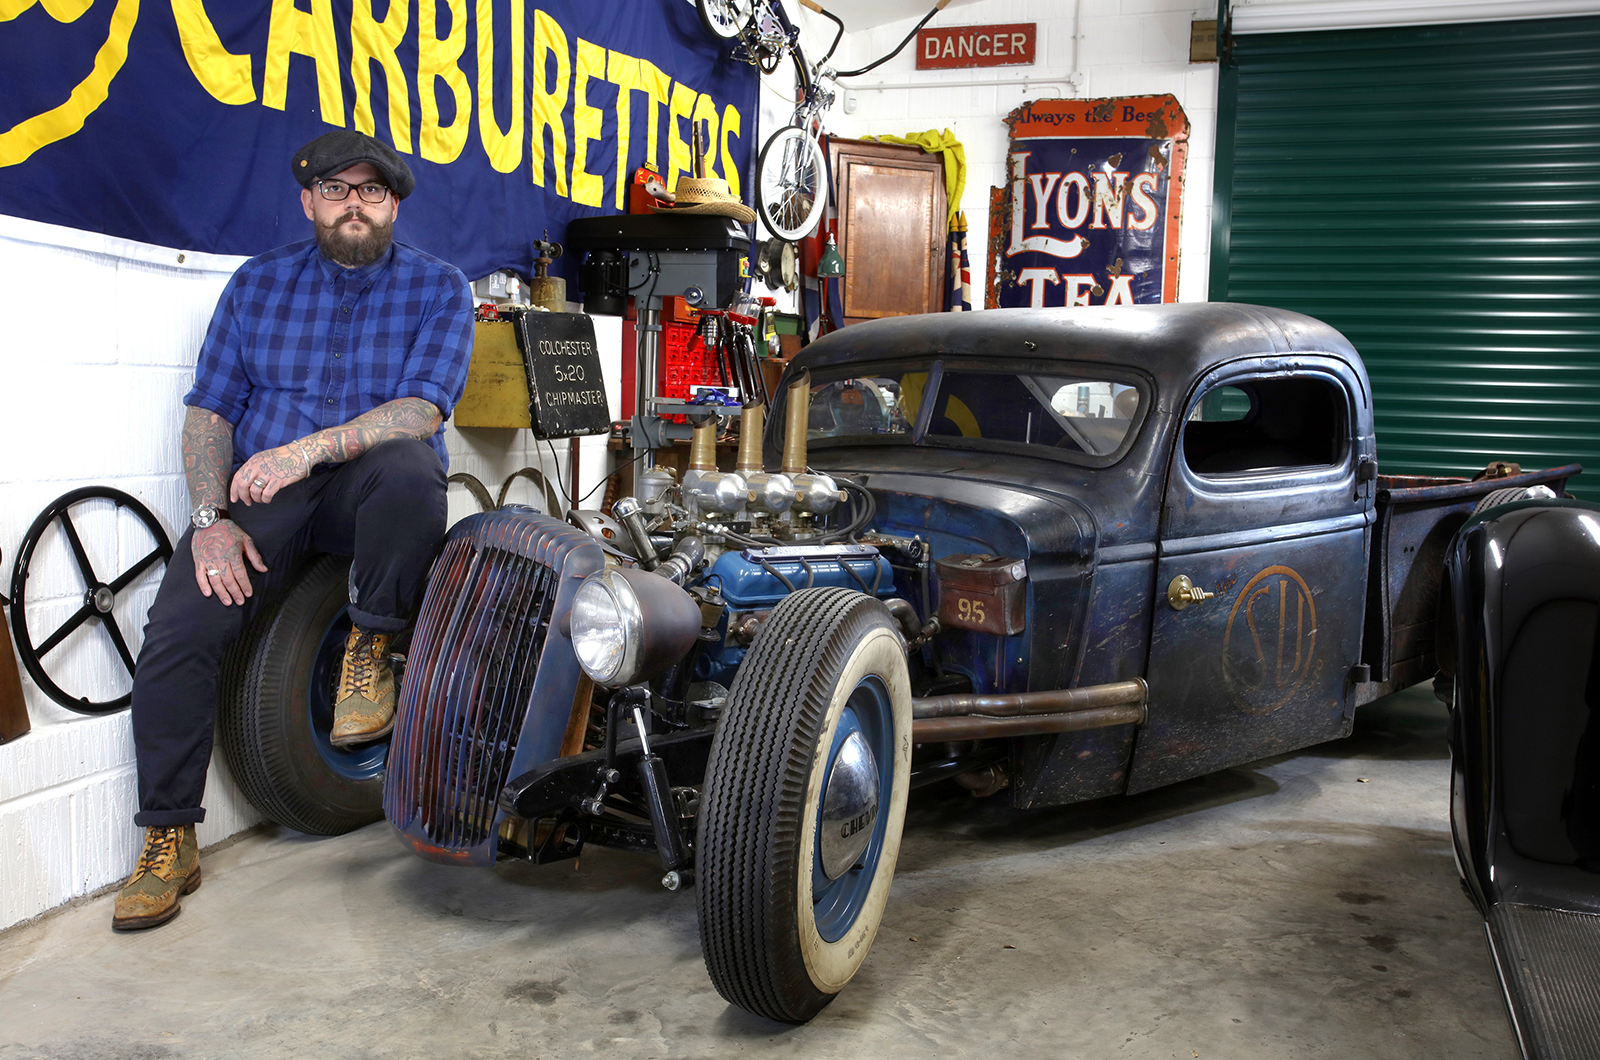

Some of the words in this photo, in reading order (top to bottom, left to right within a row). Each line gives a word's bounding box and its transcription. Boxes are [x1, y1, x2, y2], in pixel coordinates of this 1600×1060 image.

[925, 32, 1027, 59] DANGER
[1015, 107, 1075, 126] Always
[1084, 107, 1113, 123] the
[1121, 106, 1155, 123] Bes
[1005, 151, 1159, 258] LYONS
[1016, 266, 1136, 307] TEA
[539, 340, 593, 356] COLCHESTER
[546, 390, 603, 407] CHIPMASTER
[957, 597, 986, 624] 95
